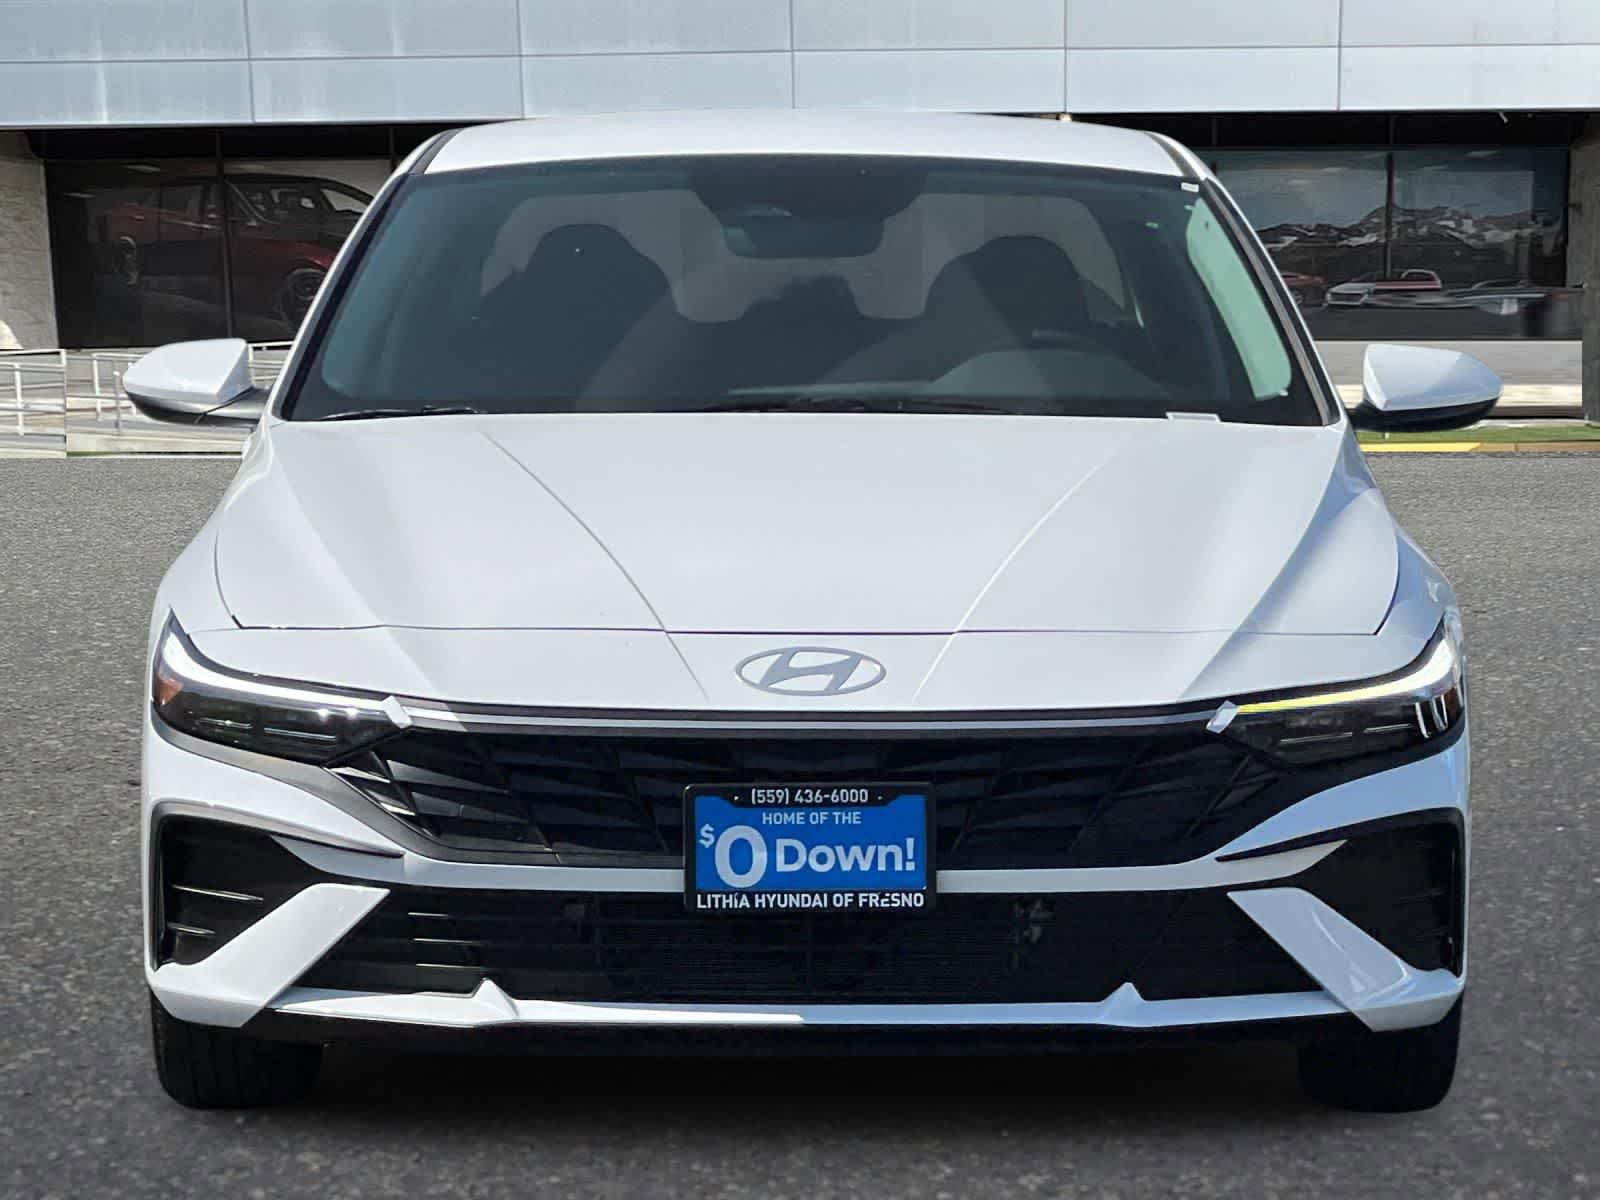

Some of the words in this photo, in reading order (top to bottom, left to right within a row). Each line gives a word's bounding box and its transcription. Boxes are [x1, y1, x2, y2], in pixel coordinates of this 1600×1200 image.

[751, 788, 790, 804] (559)
[794, 789, 869, 804] 436-6000
[762, 812, 805, 825] HOME
[809, 812, 829, 825] OF
[832, 812, 862, 825] THE
[775, 837, 916, 872] Down!
[754, 892, 828, 908] HYUNDAI
[832, 892, 854, 908] OF
